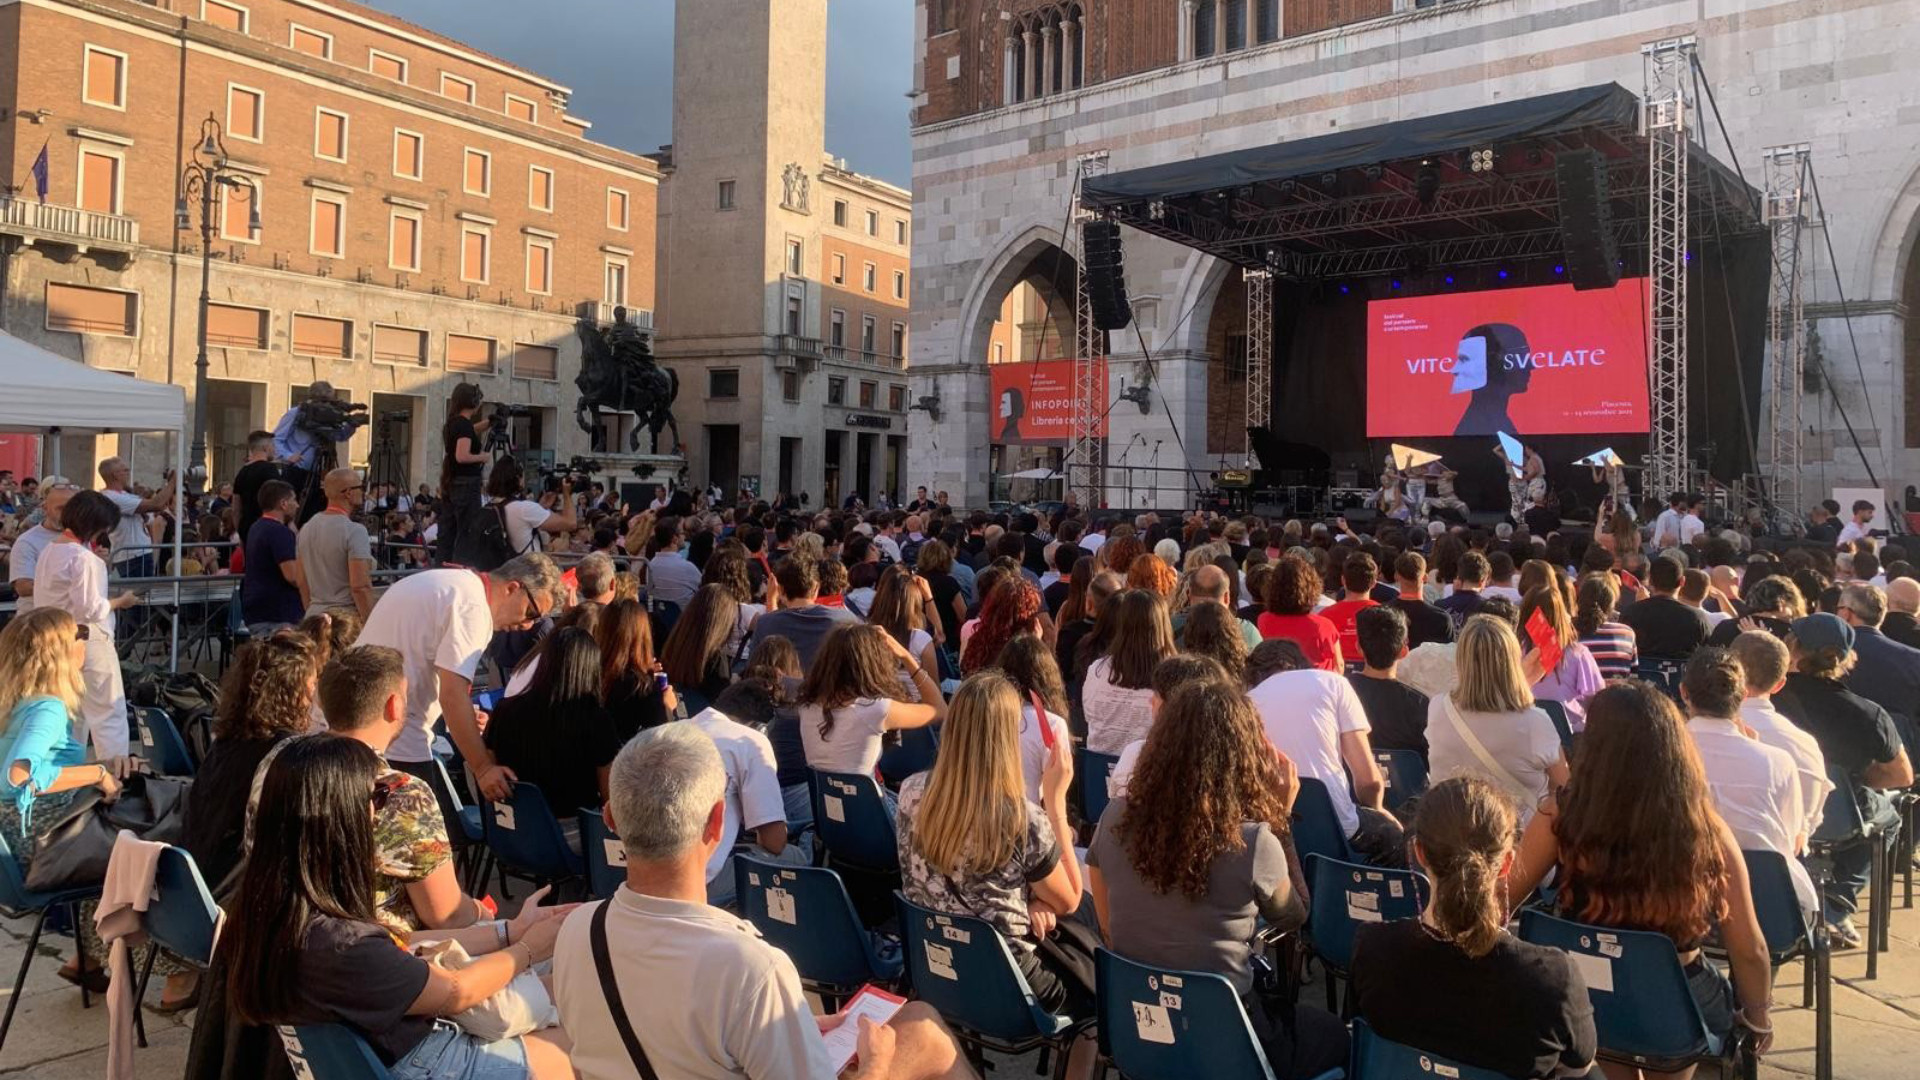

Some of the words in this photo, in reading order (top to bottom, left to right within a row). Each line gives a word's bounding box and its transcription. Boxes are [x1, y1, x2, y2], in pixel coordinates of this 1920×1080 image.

[1031, 398, 1087, 410] INFOPOI
[1031, 414, 1063, 426] Libreria
[947, 929, 958, 938] 14
[1163, 996, 1177, 1006] 13
